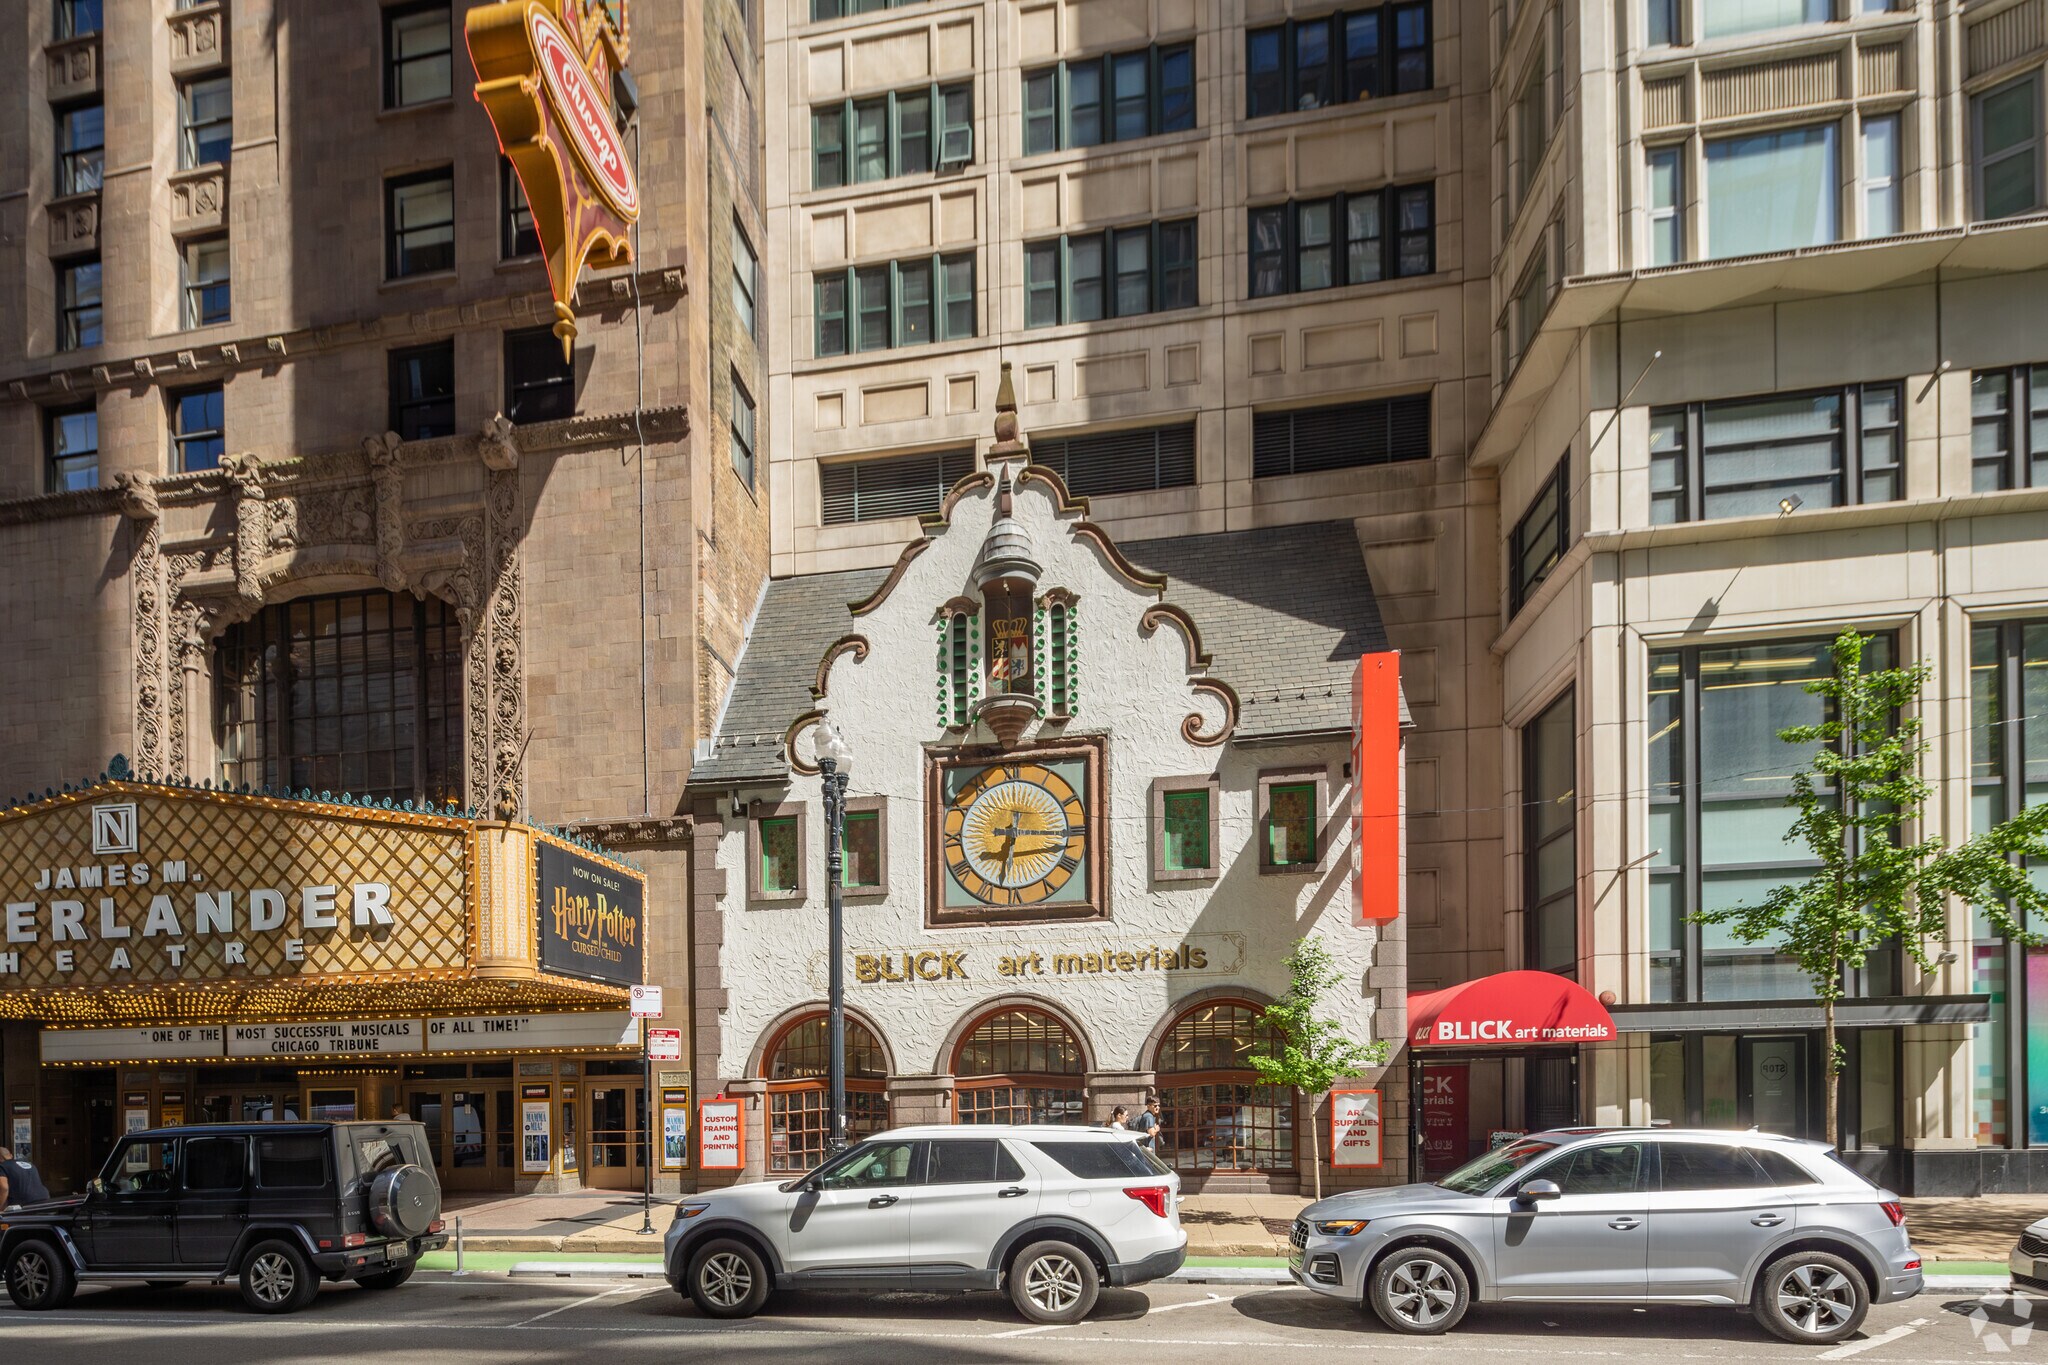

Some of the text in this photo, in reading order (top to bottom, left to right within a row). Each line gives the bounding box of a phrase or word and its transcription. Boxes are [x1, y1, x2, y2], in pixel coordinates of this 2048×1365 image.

[562, 62, 617, 171] Chicago
[98, 811, 129, 847] N
[34, 860, 202, 891] JAMES M.
[572, 866, 620, 892] NOW ON SALE!
[6, 882, 395, 943] ERLANDER
[551, 886, 637, 951] Harry Potter
[571, 940, 622, 962] CURSED CHILD
[855, 943, 1209, 982] BLICK art materials
[178, 1030, 192, 1041] OF
[199, 1029, 220, 1041] THE
[236, 1028, 266, 1040] MOST
[274, 1025, 344, 1039] SUCCESSFUL
[352, 1023, 410, 1036] MUSICALS
[430, 1022, 446, 1034] OF
[452, 1020, 475, 1033] ALL
[1438, 1020, 1608, 1040] BLICK art materials
[271, 1038, 380, 1053] CHICAGO TRIBUNE
[526, 1112, 547, 1122] MAMMA
[1343, 1139, 1371, 1147] GIFTS
